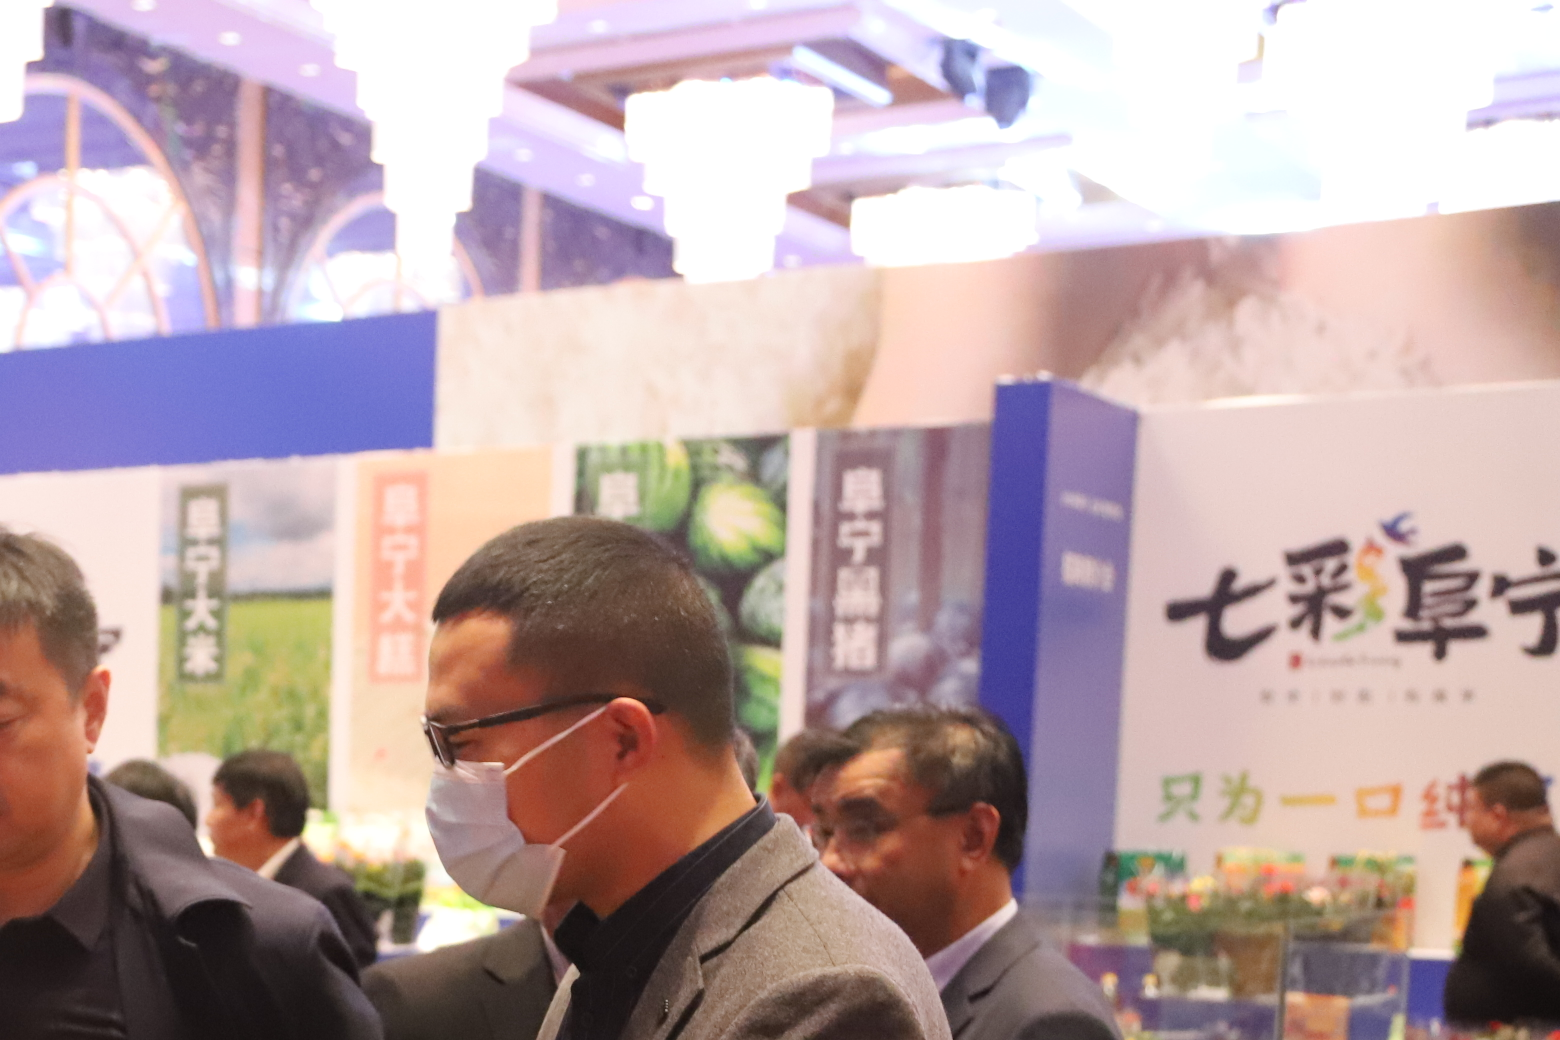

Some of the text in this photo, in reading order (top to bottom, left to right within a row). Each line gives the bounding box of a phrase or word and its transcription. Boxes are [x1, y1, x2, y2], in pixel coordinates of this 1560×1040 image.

[182, 495, 224, 680] 阜宁大米
[1164, 537, 1560, 662] 七彩阜宁
